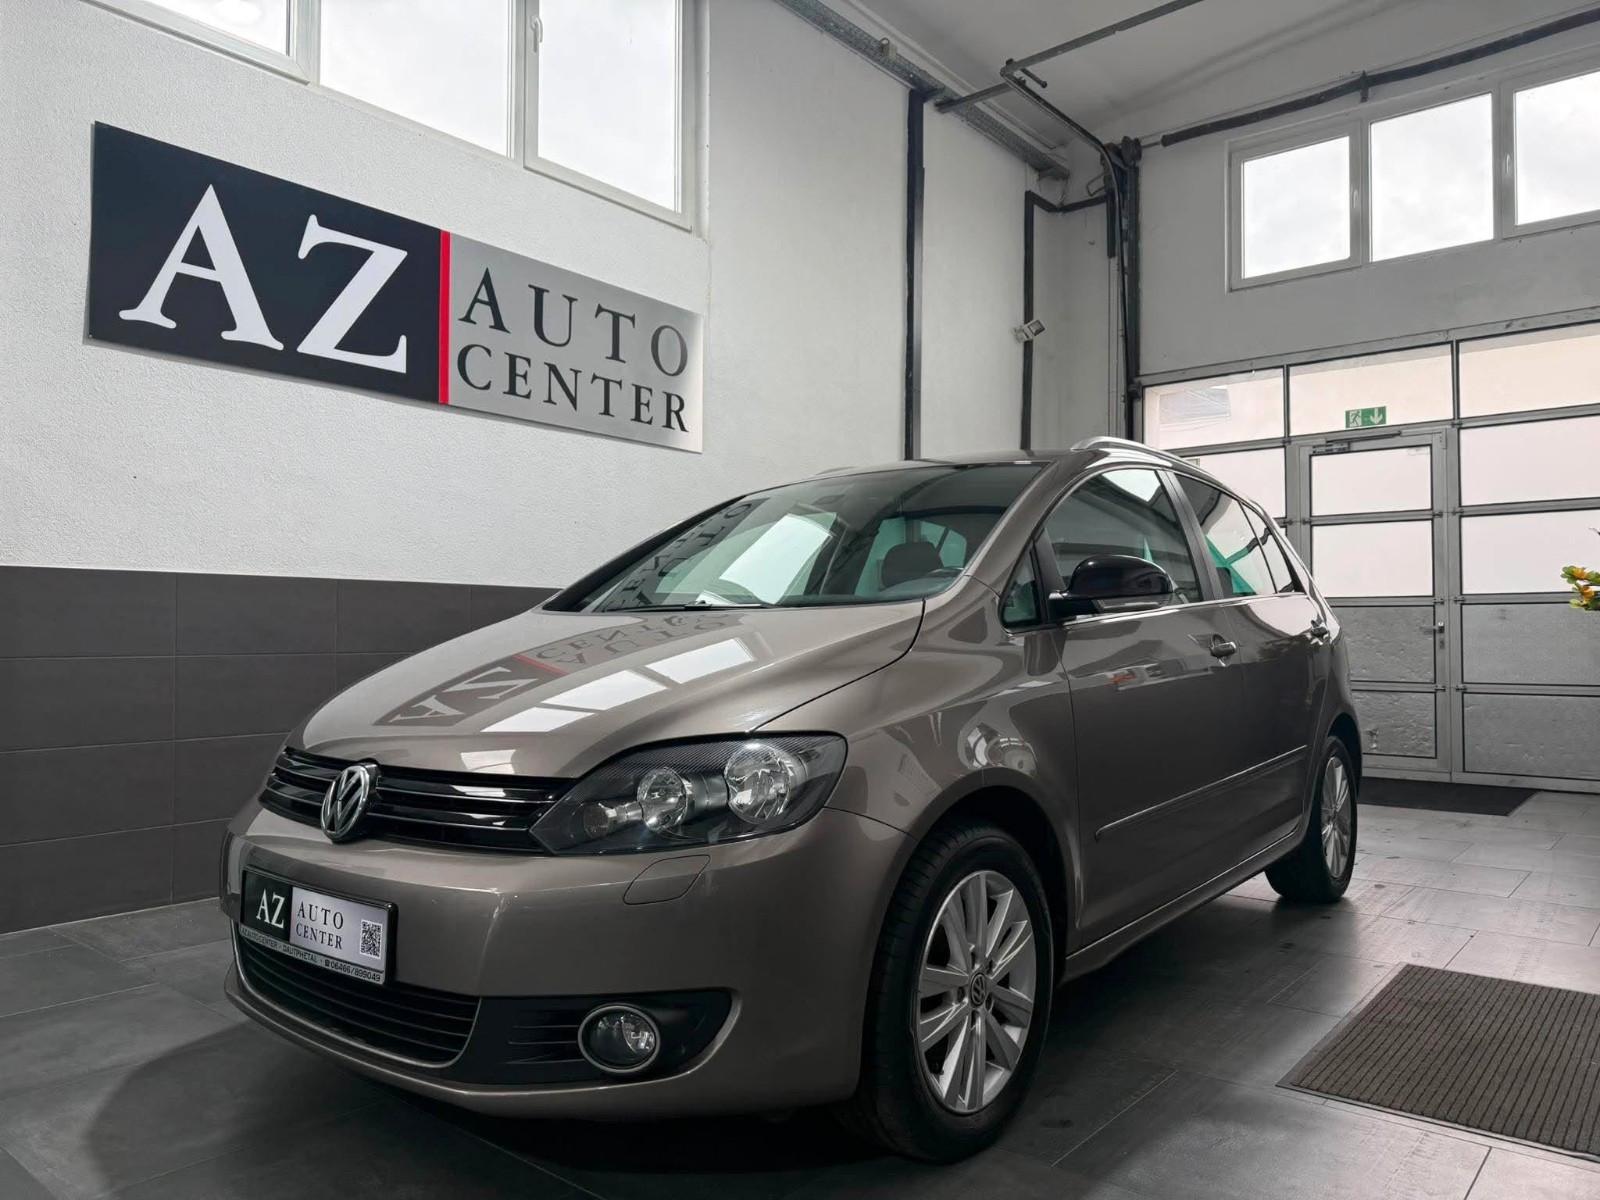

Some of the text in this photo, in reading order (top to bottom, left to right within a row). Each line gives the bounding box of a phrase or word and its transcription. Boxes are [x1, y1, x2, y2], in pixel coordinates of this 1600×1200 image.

[118, 183, 408, 374] AZ
[457, 266, 689, 378] AUTO
[456, 343, 690, 433] CENTER
[255, 888, 286, 930] AZ
[295, 922, 343, 950] CENTER
[296, 900, 344, 930] AUTO
